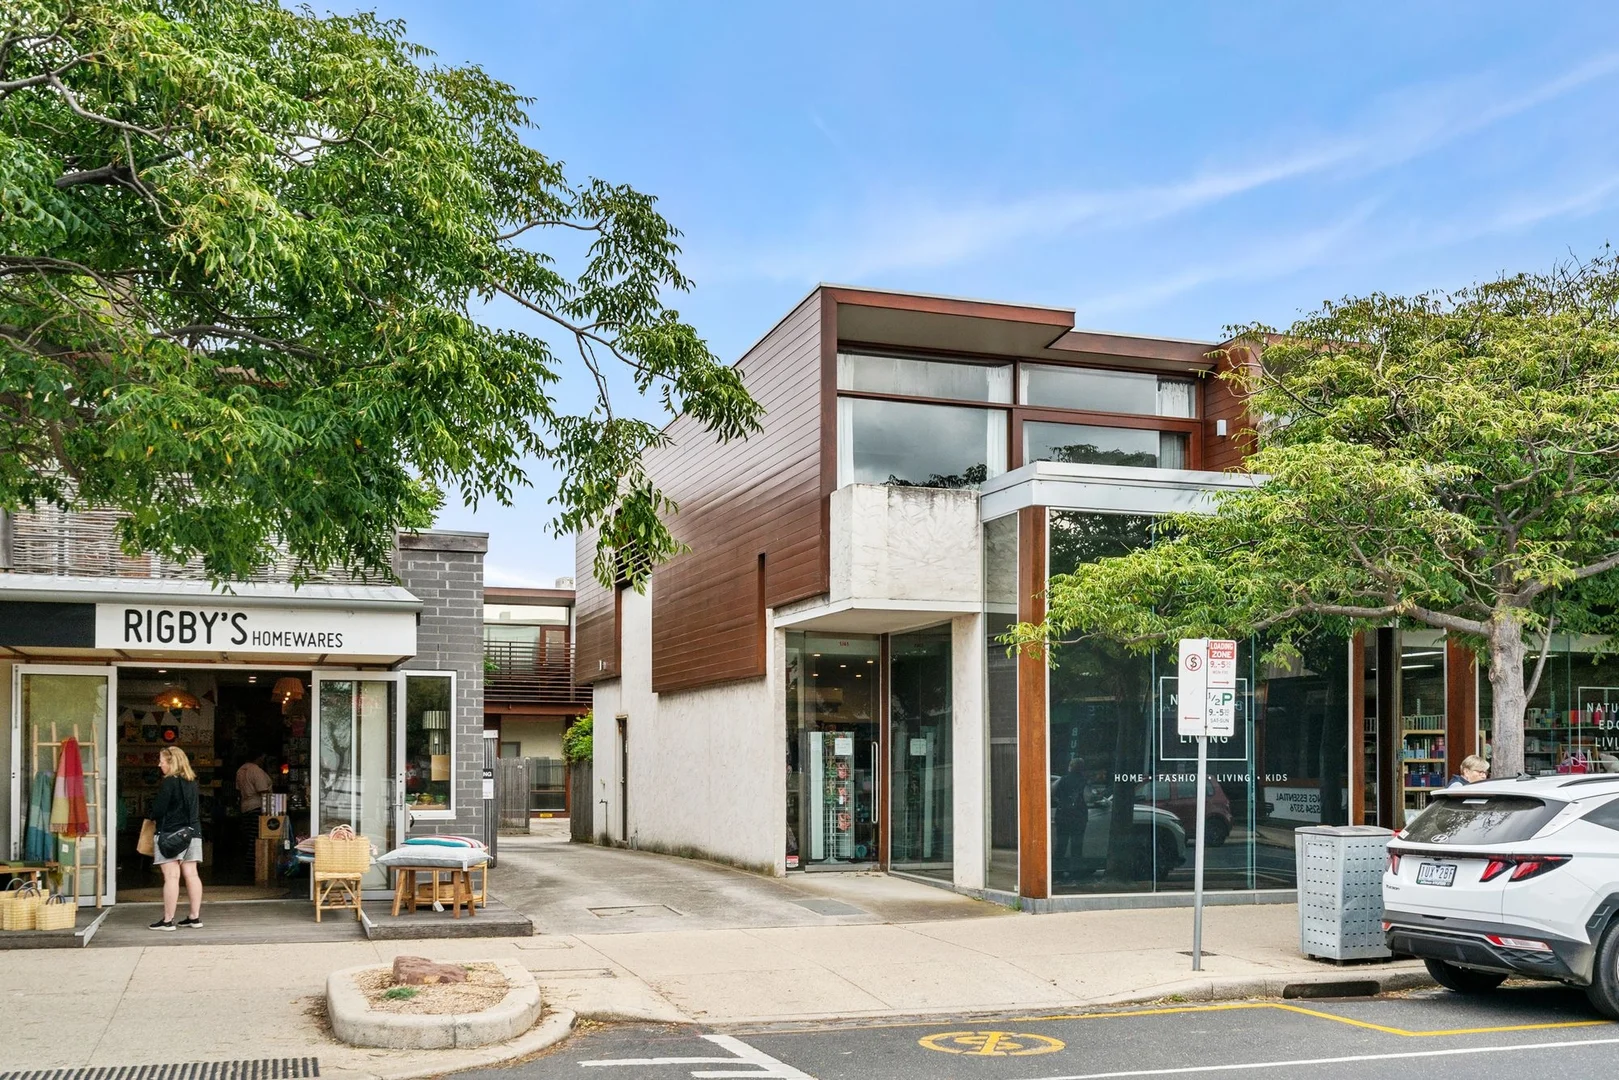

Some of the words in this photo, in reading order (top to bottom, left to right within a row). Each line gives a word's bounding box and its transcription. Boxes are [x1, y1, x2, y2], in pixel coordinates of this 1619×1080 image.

[124, 608, 248, 645] RIGBY'S
[252, 630, 343, 648] HOMEWARES
[1210, 642, 1234, 650] LOADING
[1114, 773, 1143, 783] HOME
[1158, 773, 1196, 782] FASHIO
[1216, 773, 1250, 782] LIVING
[1265, 773, 1288, 782] KIDS
